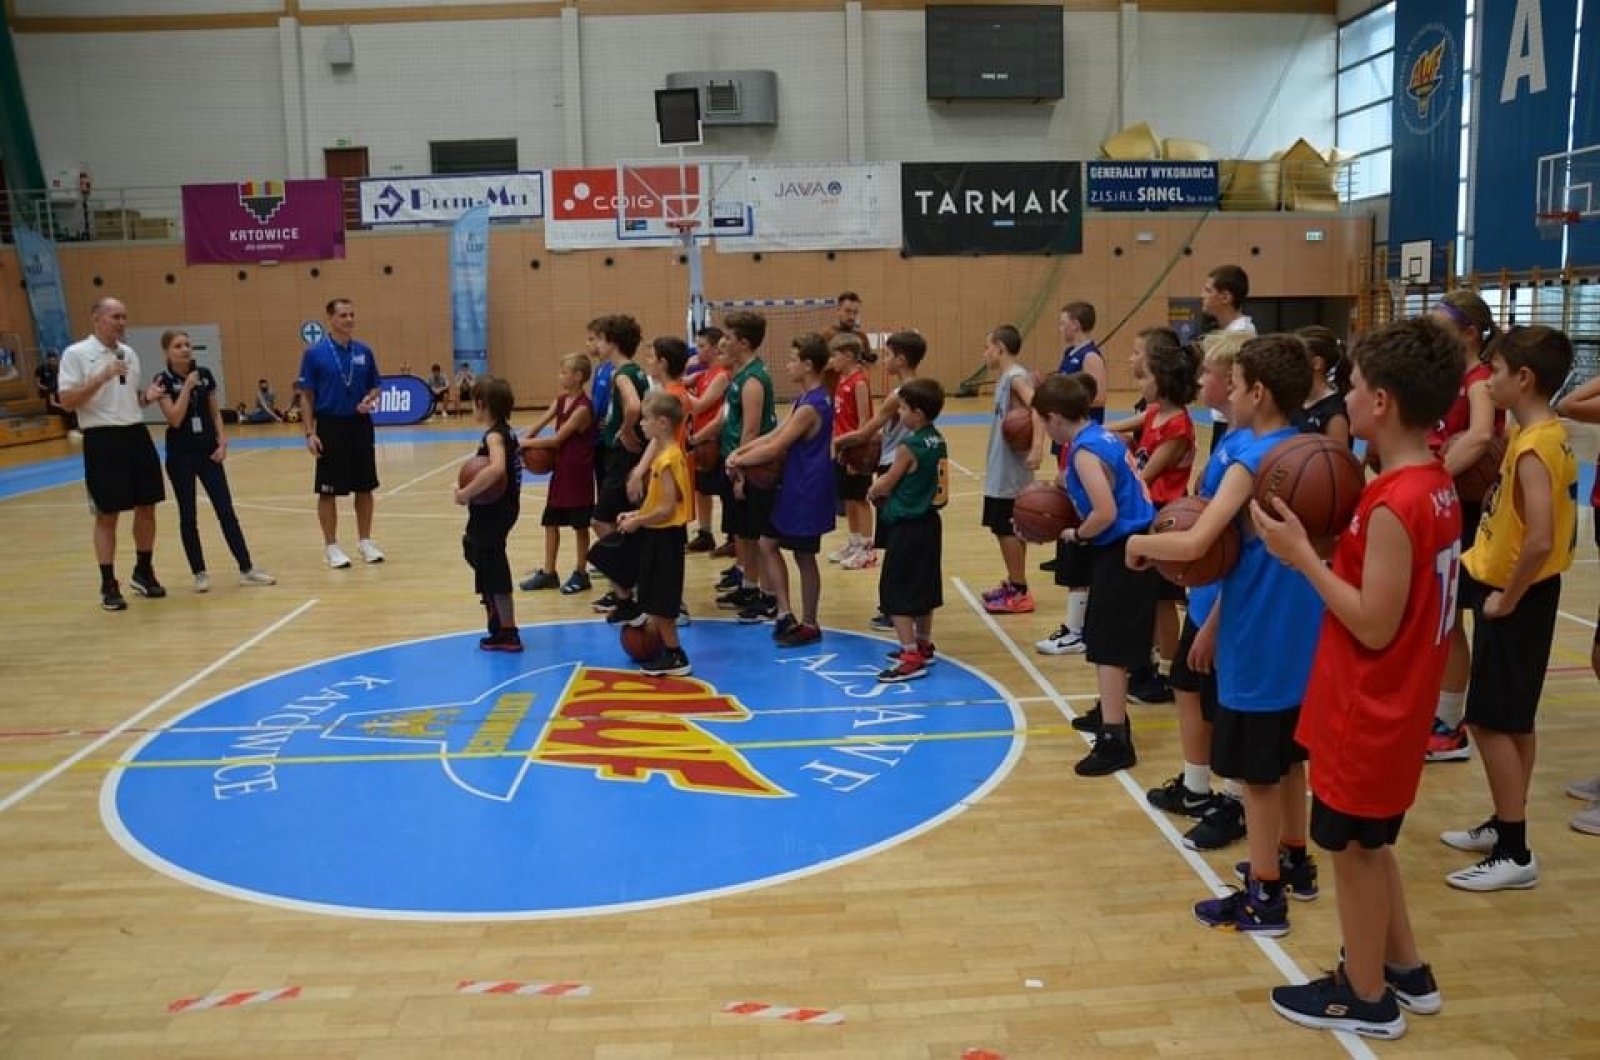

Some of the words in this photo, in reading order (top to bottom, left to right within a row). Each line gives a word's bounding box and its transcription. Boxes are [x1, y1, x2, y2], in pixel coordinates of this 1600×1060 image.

[1501, 0, 1547, 103] A
[1090, 166, 1148, 179] GENERALNY
[1150, 166, 1214, 179] WYKONAWCA
[593, 194, 654, 211] COIG
[914, 188, 1070, 215] TARMAK
[229, 227, 300, 241] KATOWICE
[381, 386, 411, 413] nba
[213, 674, 394, 801] KATOWICE
